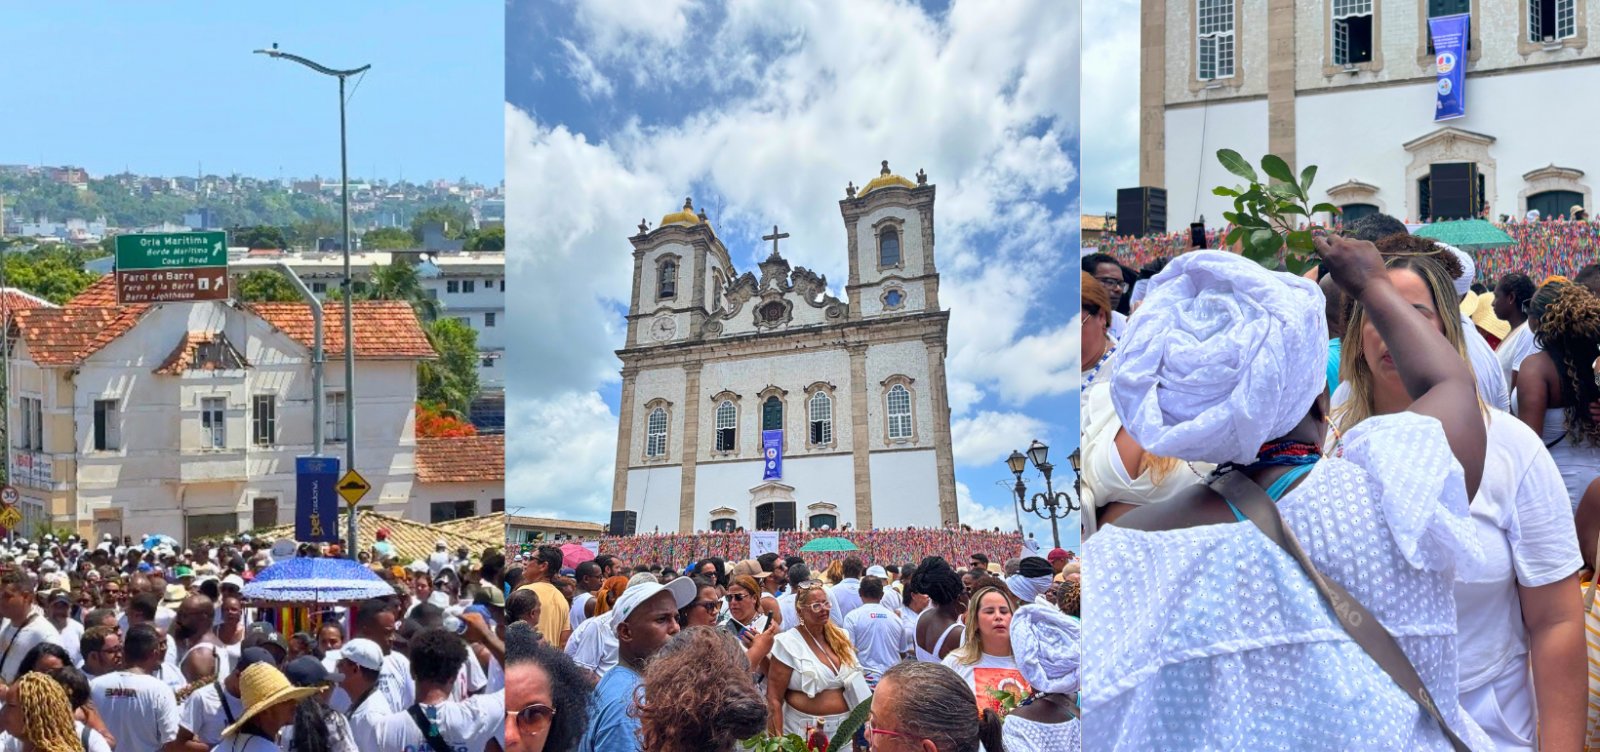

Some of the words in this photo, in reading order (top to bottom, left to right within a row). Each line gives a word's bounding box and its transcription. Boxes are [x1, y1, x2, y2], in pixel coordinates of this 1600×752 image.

[147, 248, 170, 256] Borde
[162, 257, 184, 265] Coast
[188, 255, 208, 264] Road
[122, 273, 148, 282] Farol
[122, 284, 142, 292] Faro
[172, 282, 195, 290] Barra
[125, 292, 148, 301] Barra
[4, 491, 15, 499] 30
